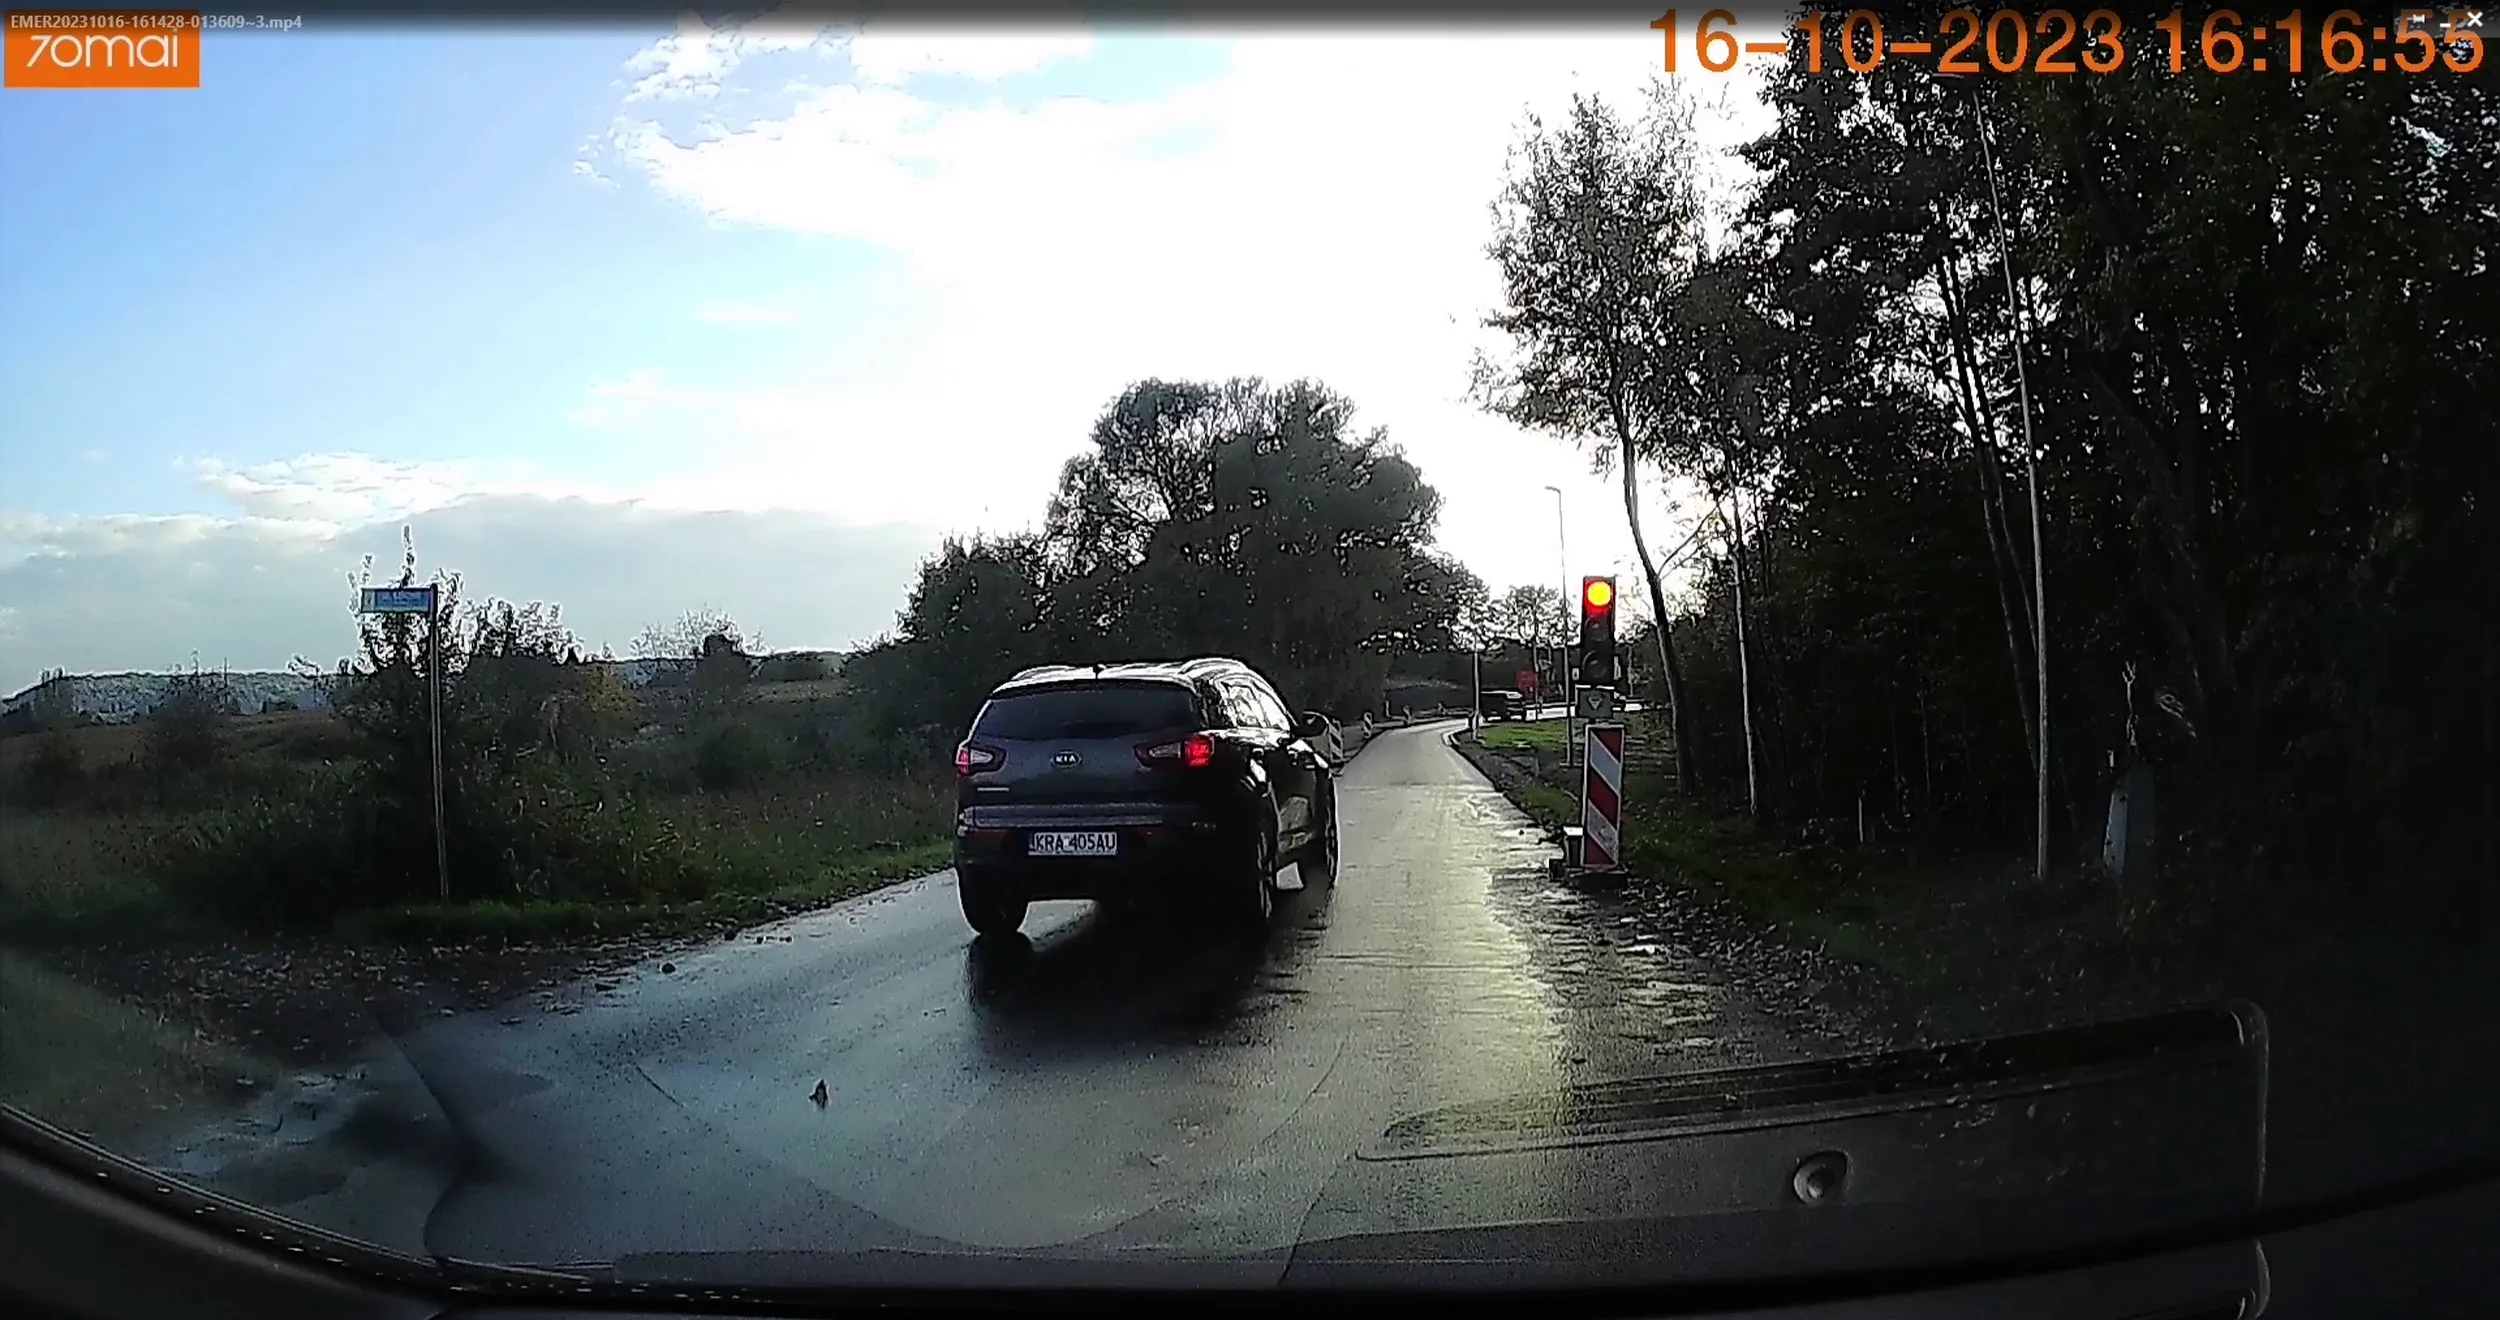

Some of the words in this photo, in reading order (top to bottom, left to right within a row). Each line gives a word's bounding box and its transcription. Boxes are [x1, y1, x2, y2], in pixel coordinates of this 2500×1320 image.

[1055, 754, 1077, 763] KIA
[1035, 833, 1064, 852] KRA
[1068, 833, 1116, 852] 405AU
